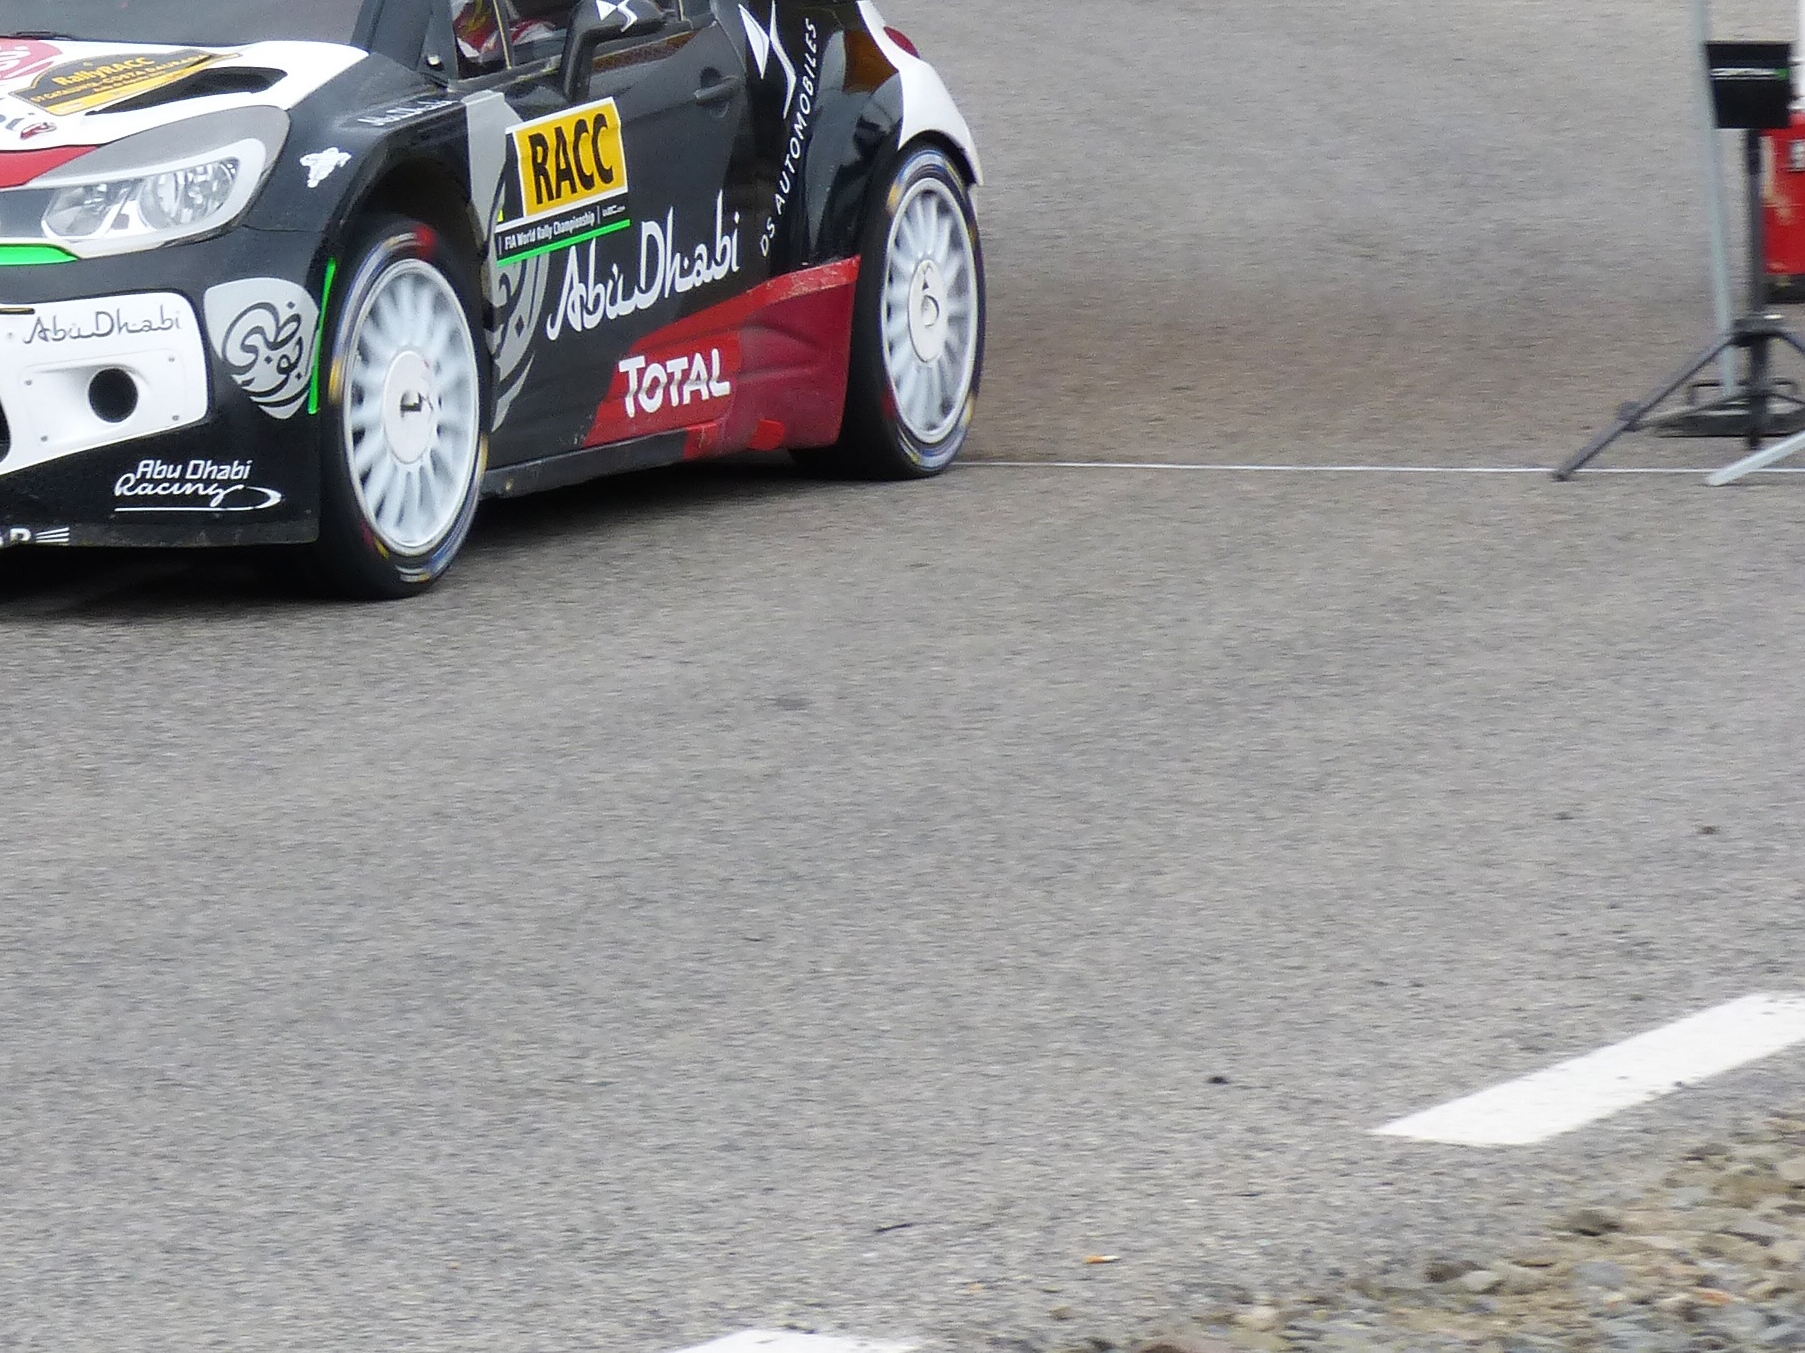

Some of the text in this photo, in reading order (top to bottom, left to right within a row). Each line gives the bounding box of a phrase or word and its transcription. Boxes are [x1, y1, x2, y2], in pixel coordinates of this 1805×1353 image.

[774, 18, 818, 216] AUTOMOBILES
[528, 113, 614, 205] RACC
[618, 348, 731, 418] TOTAL
[114, 474, 243, 508] Racing
[136, 459, 253, 481] Abu Dhabi
